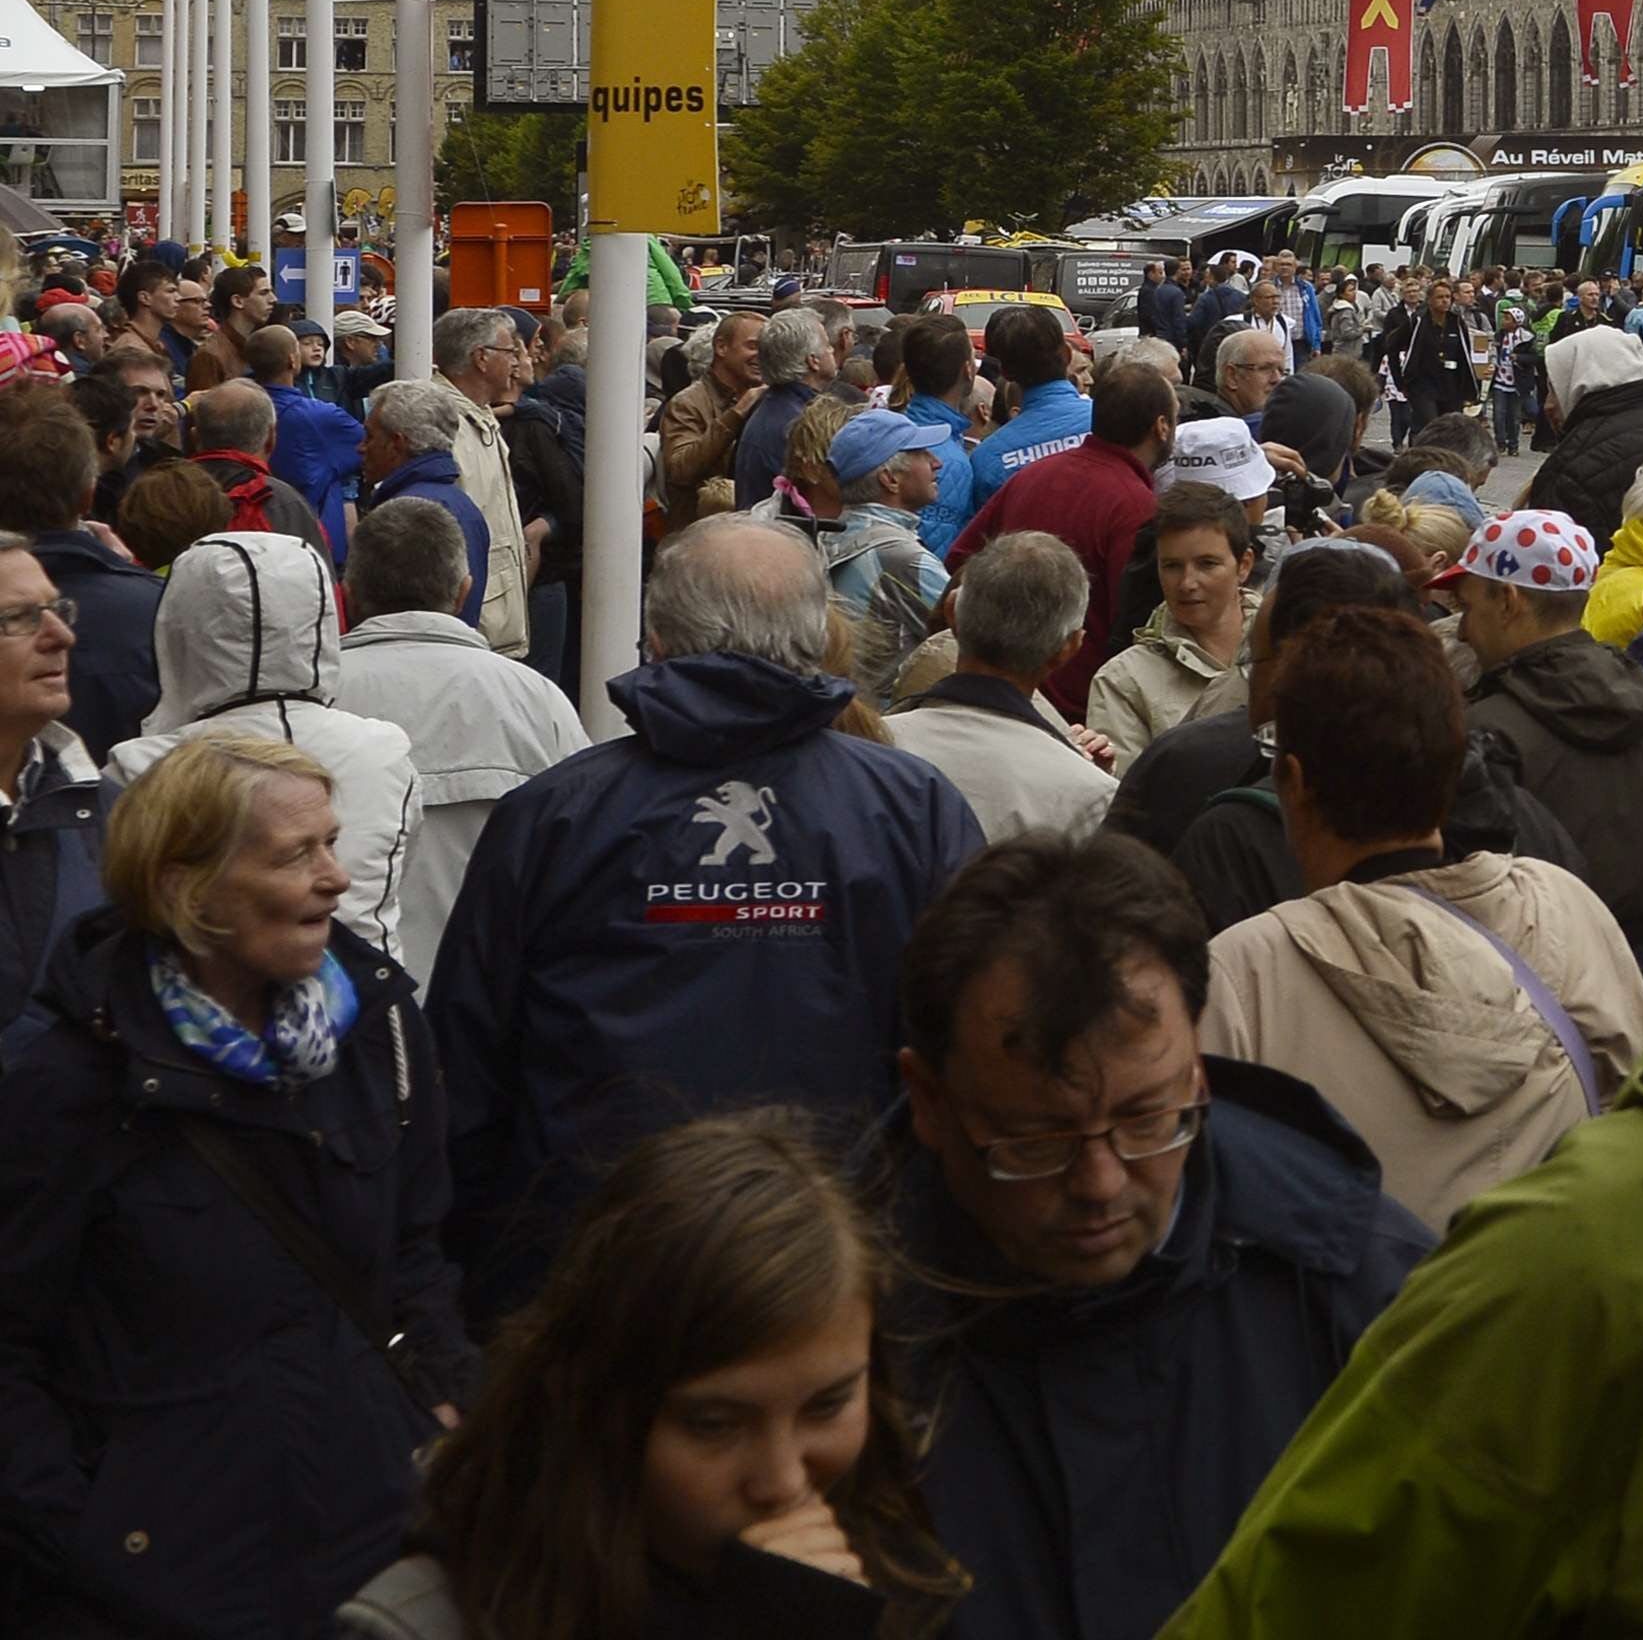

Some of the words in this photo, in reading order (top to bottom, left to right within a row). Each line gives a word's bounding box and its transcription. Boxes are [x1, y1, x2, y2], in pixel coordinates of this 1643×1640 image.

[1491, 149, 1523, 165] Au
[1531, 148, 1595, 165] Réveil
[989, 292, 1026, 303] LCL
[647, 881, 828, 902] PEUGEOT
[735, 905, 821, 920] SPORT
[711, 926, 764, 939] SOUTH
[768, 924, 822, 938] AFRICA
